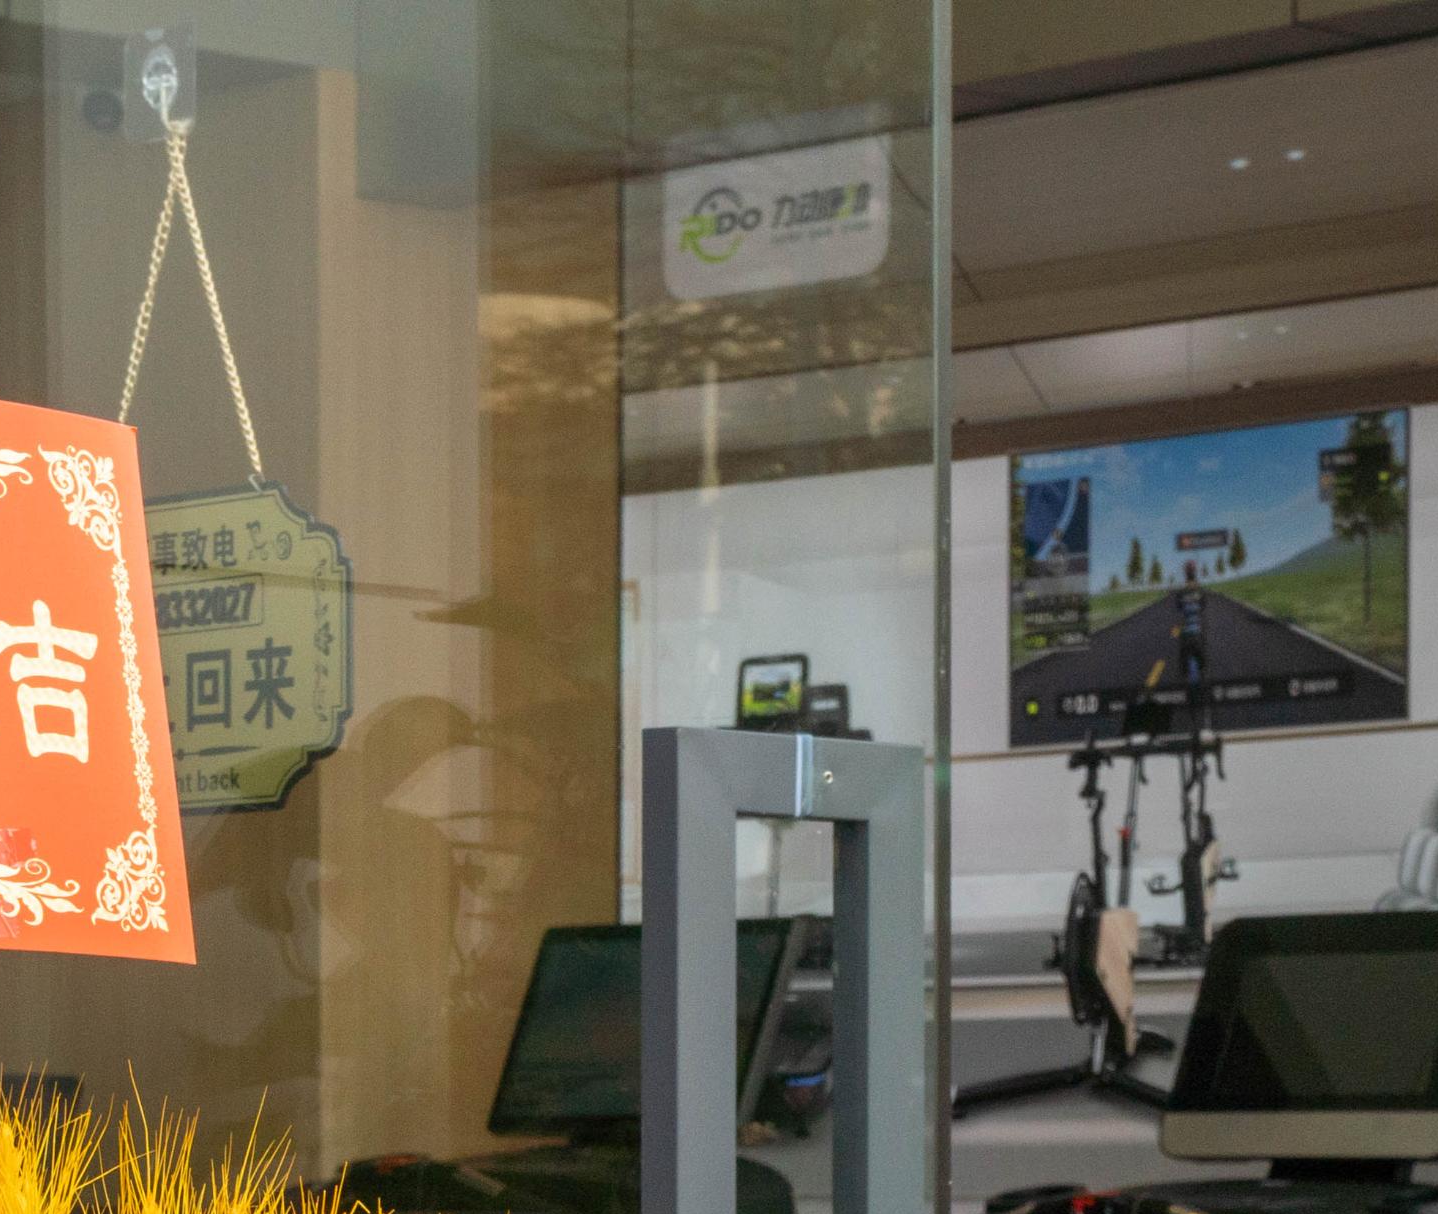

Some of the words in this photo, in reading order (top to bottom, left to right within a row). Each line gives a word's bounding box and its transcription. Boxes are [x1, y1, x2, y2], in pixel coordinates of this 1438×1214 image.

[152, 525, 237, 575] 事致电
[183, 637, 296, 732] 回来
[199, 768, 241, 793] back
